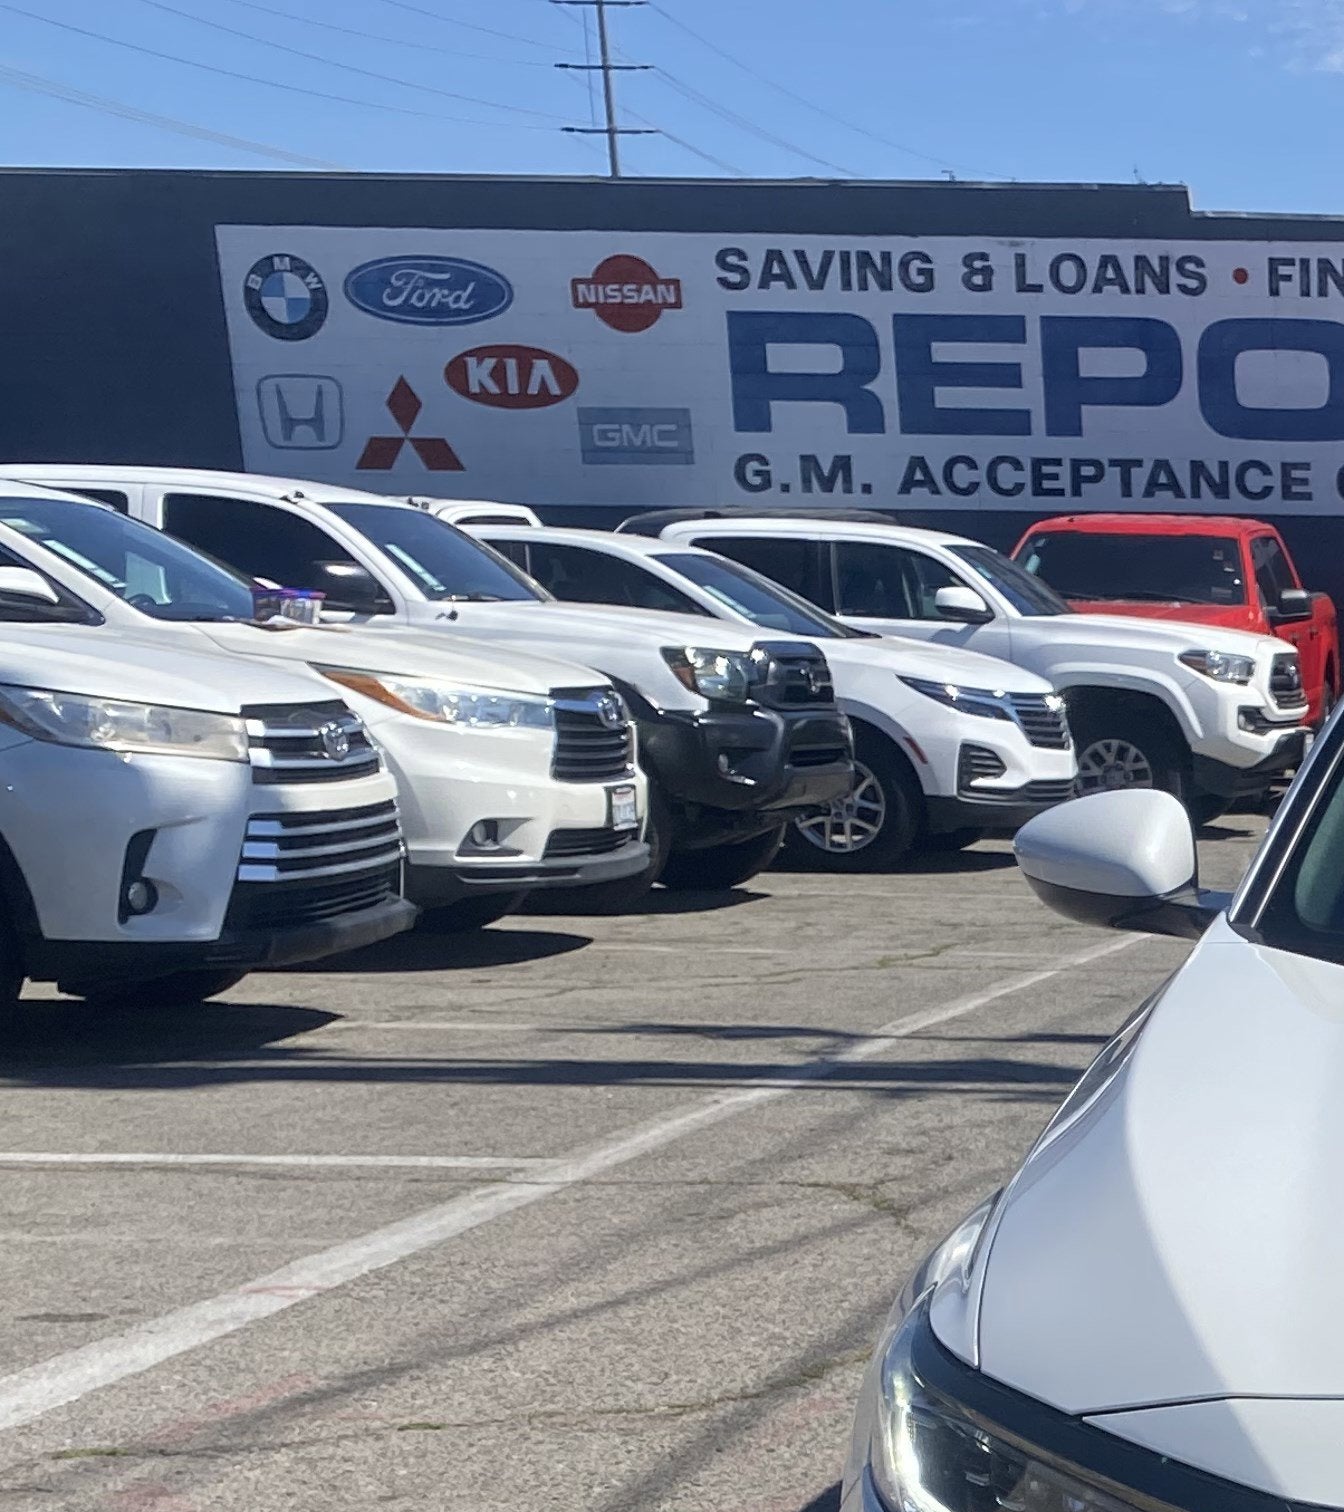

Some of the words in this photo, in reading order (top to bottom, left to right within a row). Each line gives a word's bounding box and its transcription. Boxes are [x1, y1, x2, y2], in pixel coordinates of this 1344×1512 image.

[381, 267, 475, 312] Ford
[715, 247, 936, 293] SAVING
[961, 251, 994, 293] &
[1015, 253, 1209, 296] LOANS
[577, 283, 677, 305] NISSAN
[465, 357, 562, 396] KIA
[593, 424, 680, 448] GMC
[734, 453, 872, 495] G.M.
[898, 455, 1313, 501] ACCEPTANCE
